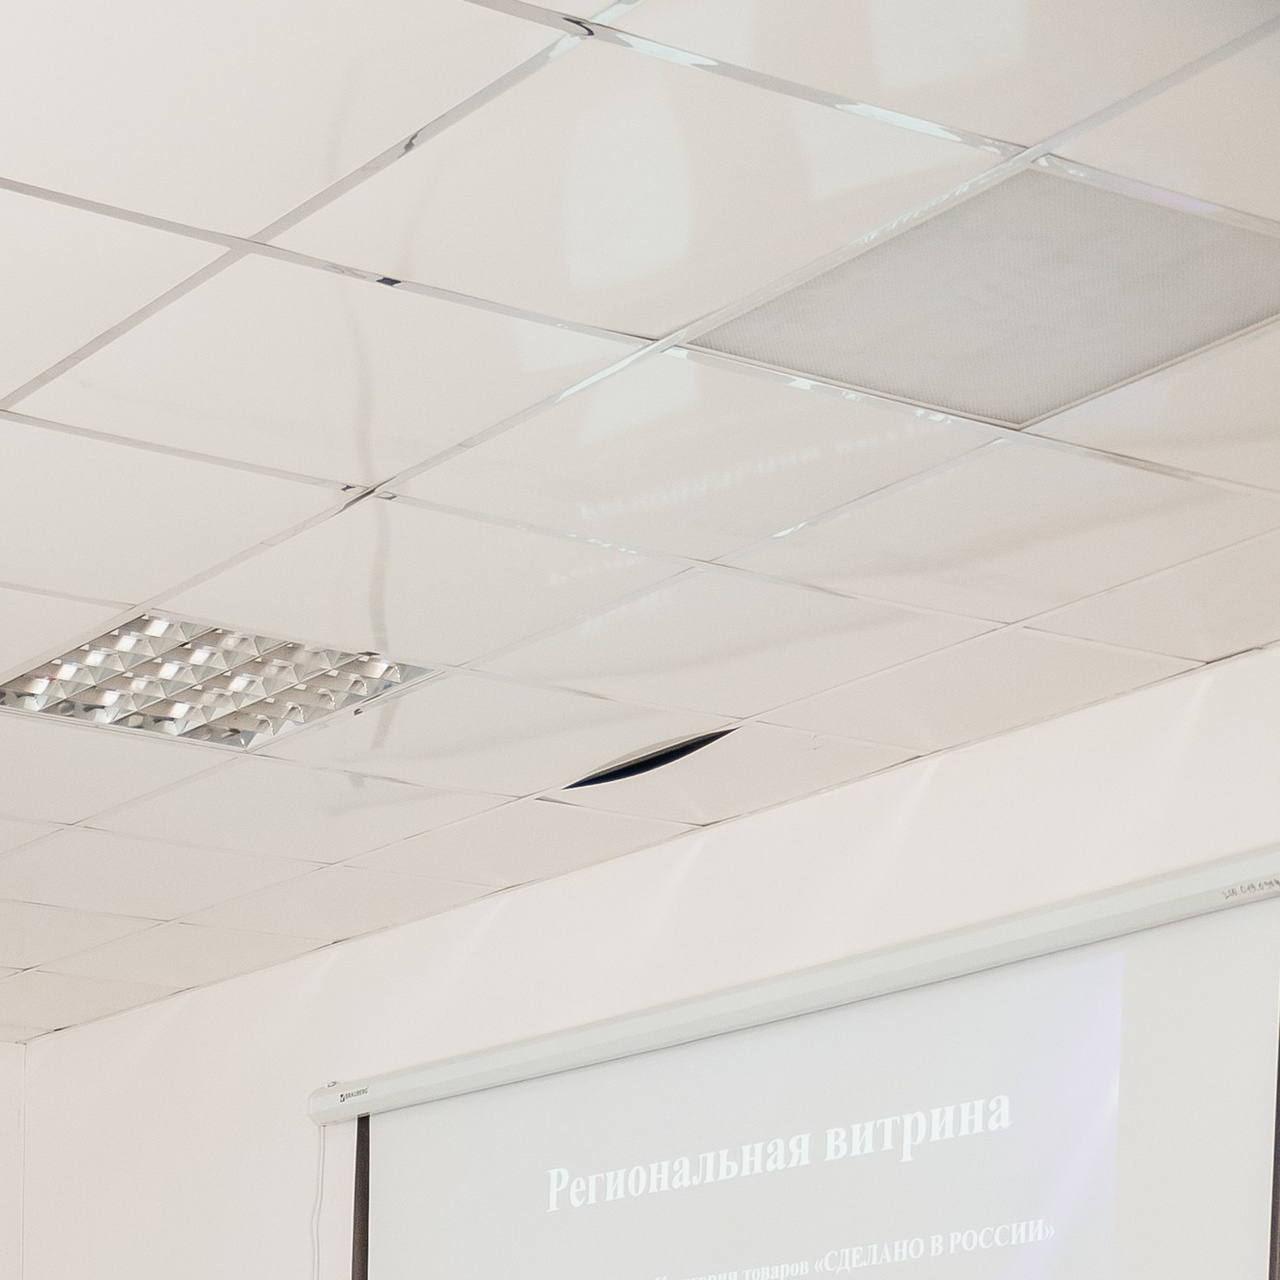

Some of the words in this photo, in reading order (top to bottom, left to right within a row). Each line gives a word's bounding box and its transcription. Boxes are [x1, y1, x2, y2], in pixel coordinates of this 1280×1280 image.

[546, 1132, 811, 1213] Региональная
[824, 1093, 1012, 1162] витрина
[814, 1237, 925, 1275] «СДЕЛАНО
[929, 1234, 944, 1257] В
[949, 1218, 1056, 1255] РОССИИ»
